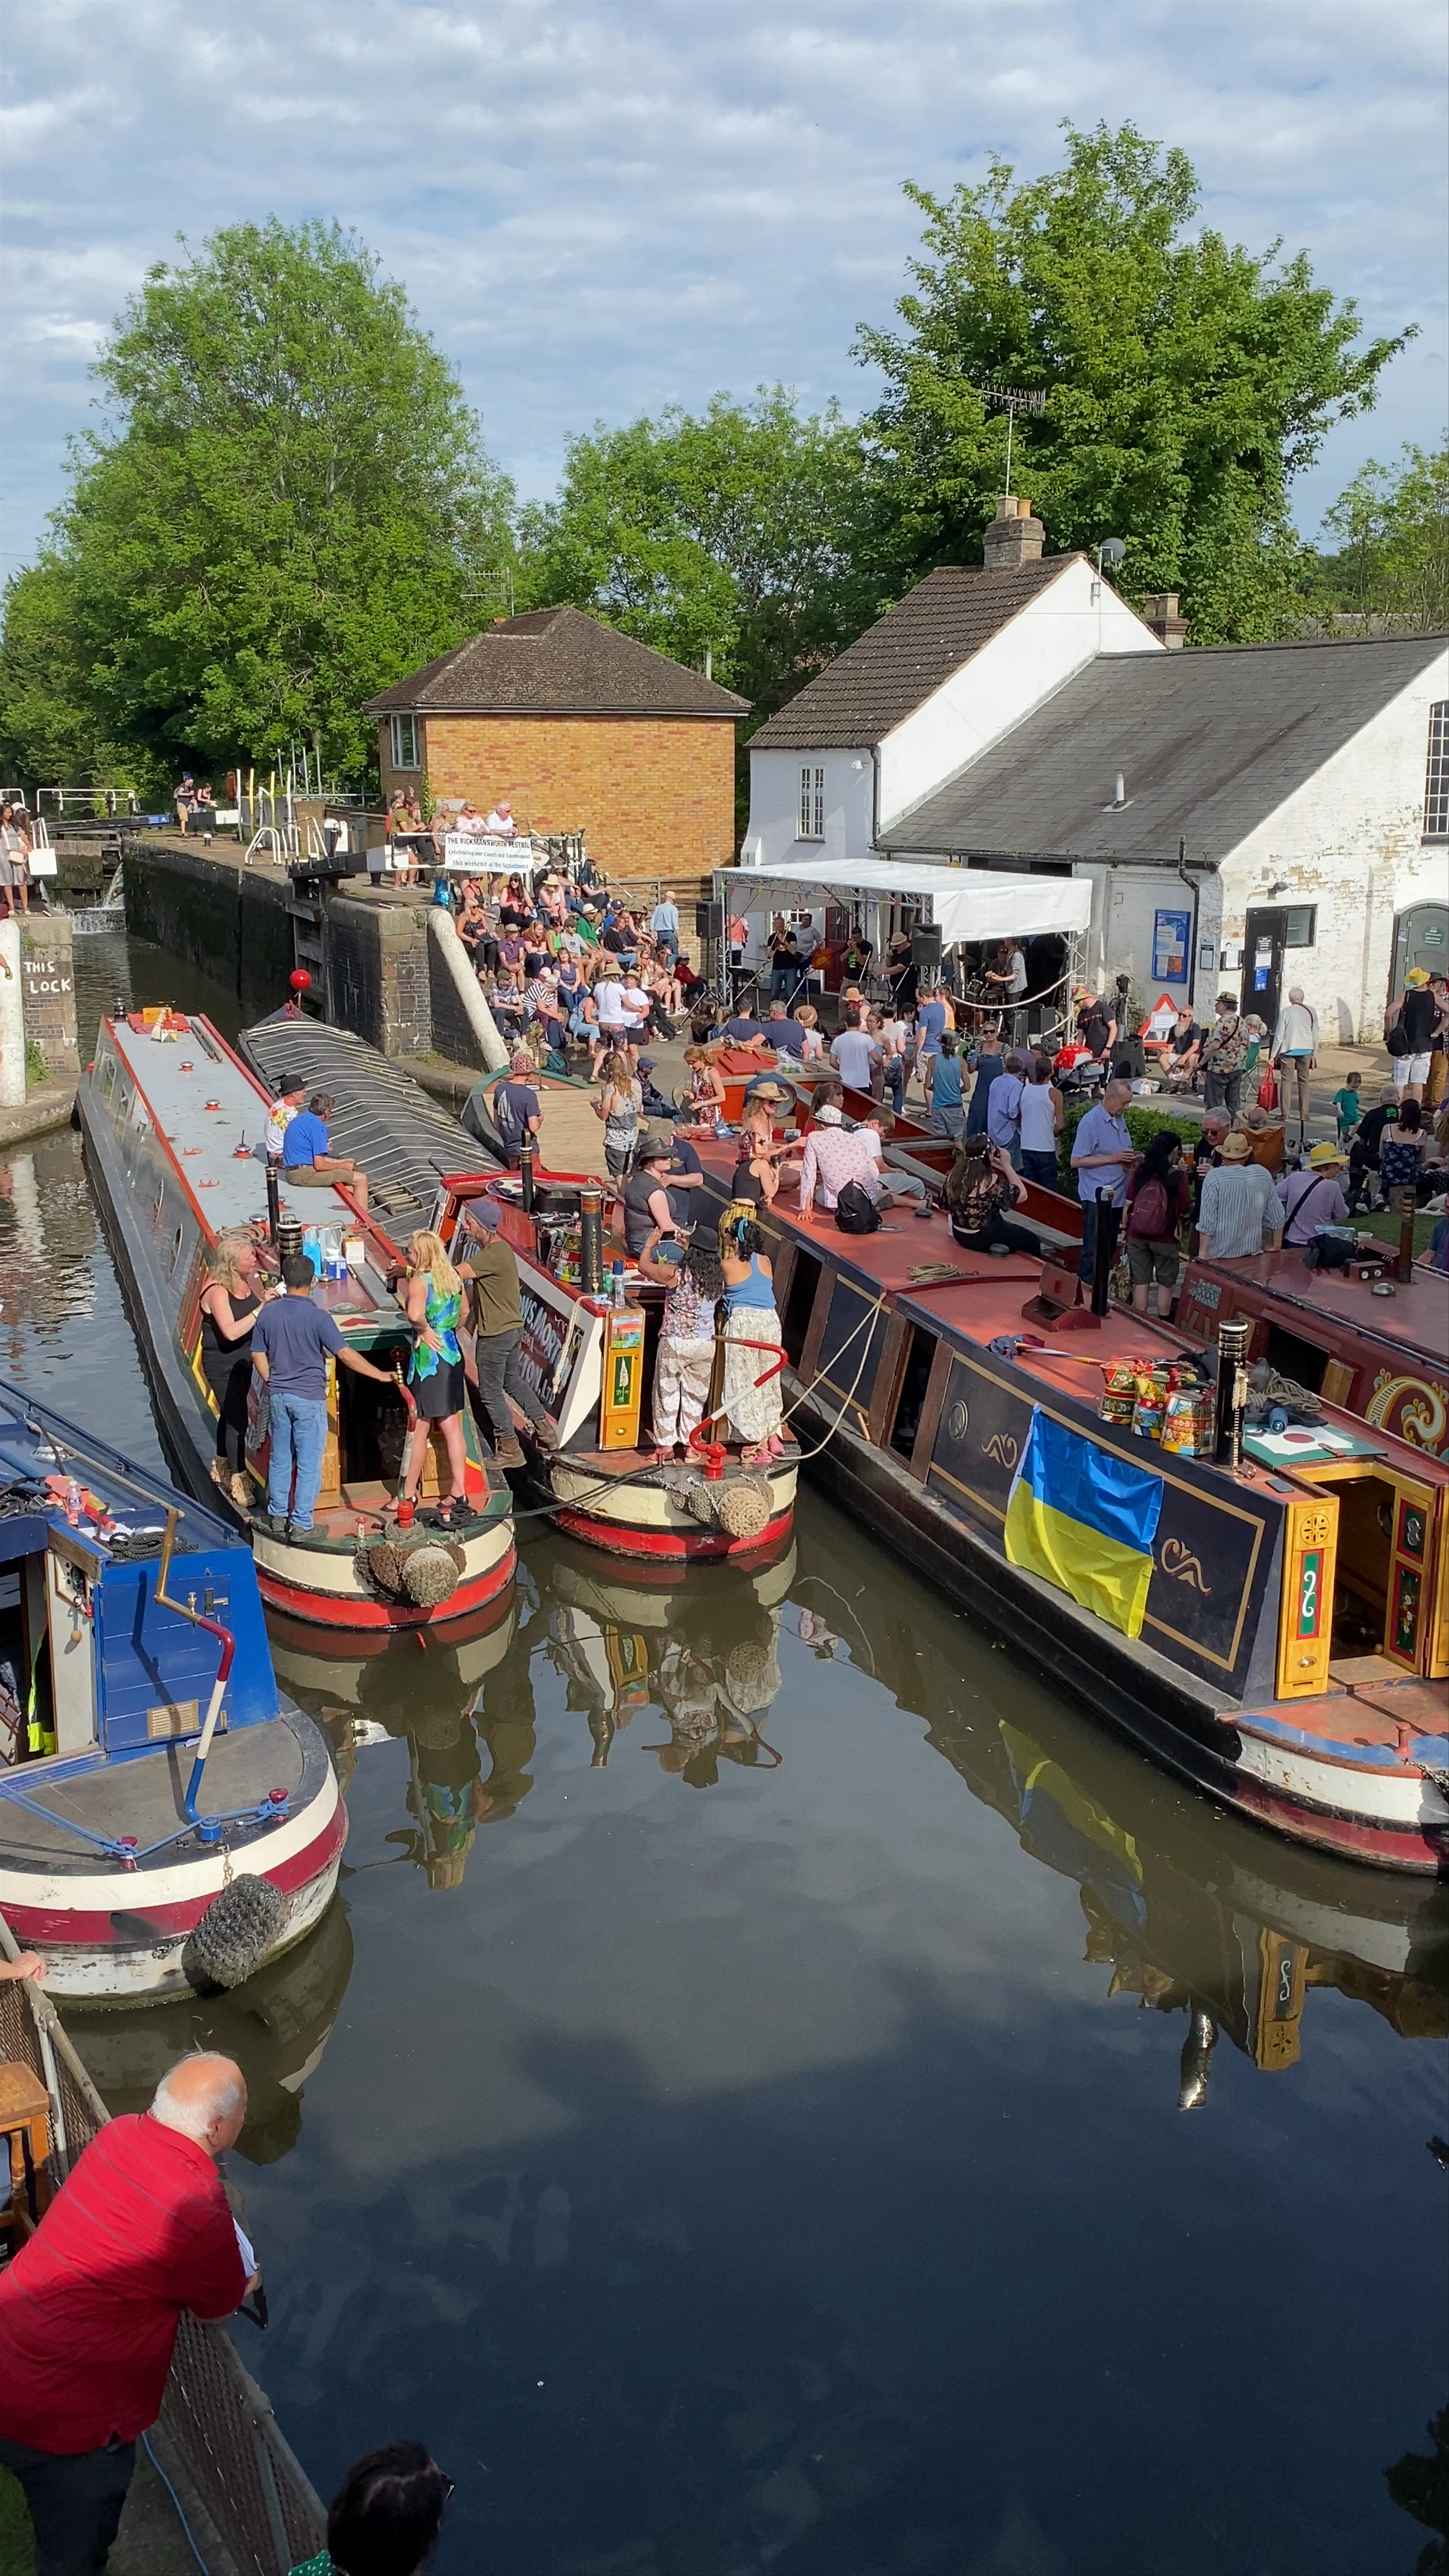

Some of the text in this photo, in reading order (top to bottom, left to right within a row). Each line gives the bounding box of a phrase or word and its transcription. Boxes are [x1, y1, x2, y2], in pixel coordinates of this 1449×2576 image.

[460, 838, 507, 847] RICKMANSWORTH
[23, 961, 55, 973] THIS
[30, 978, 71, 994] LOCK
